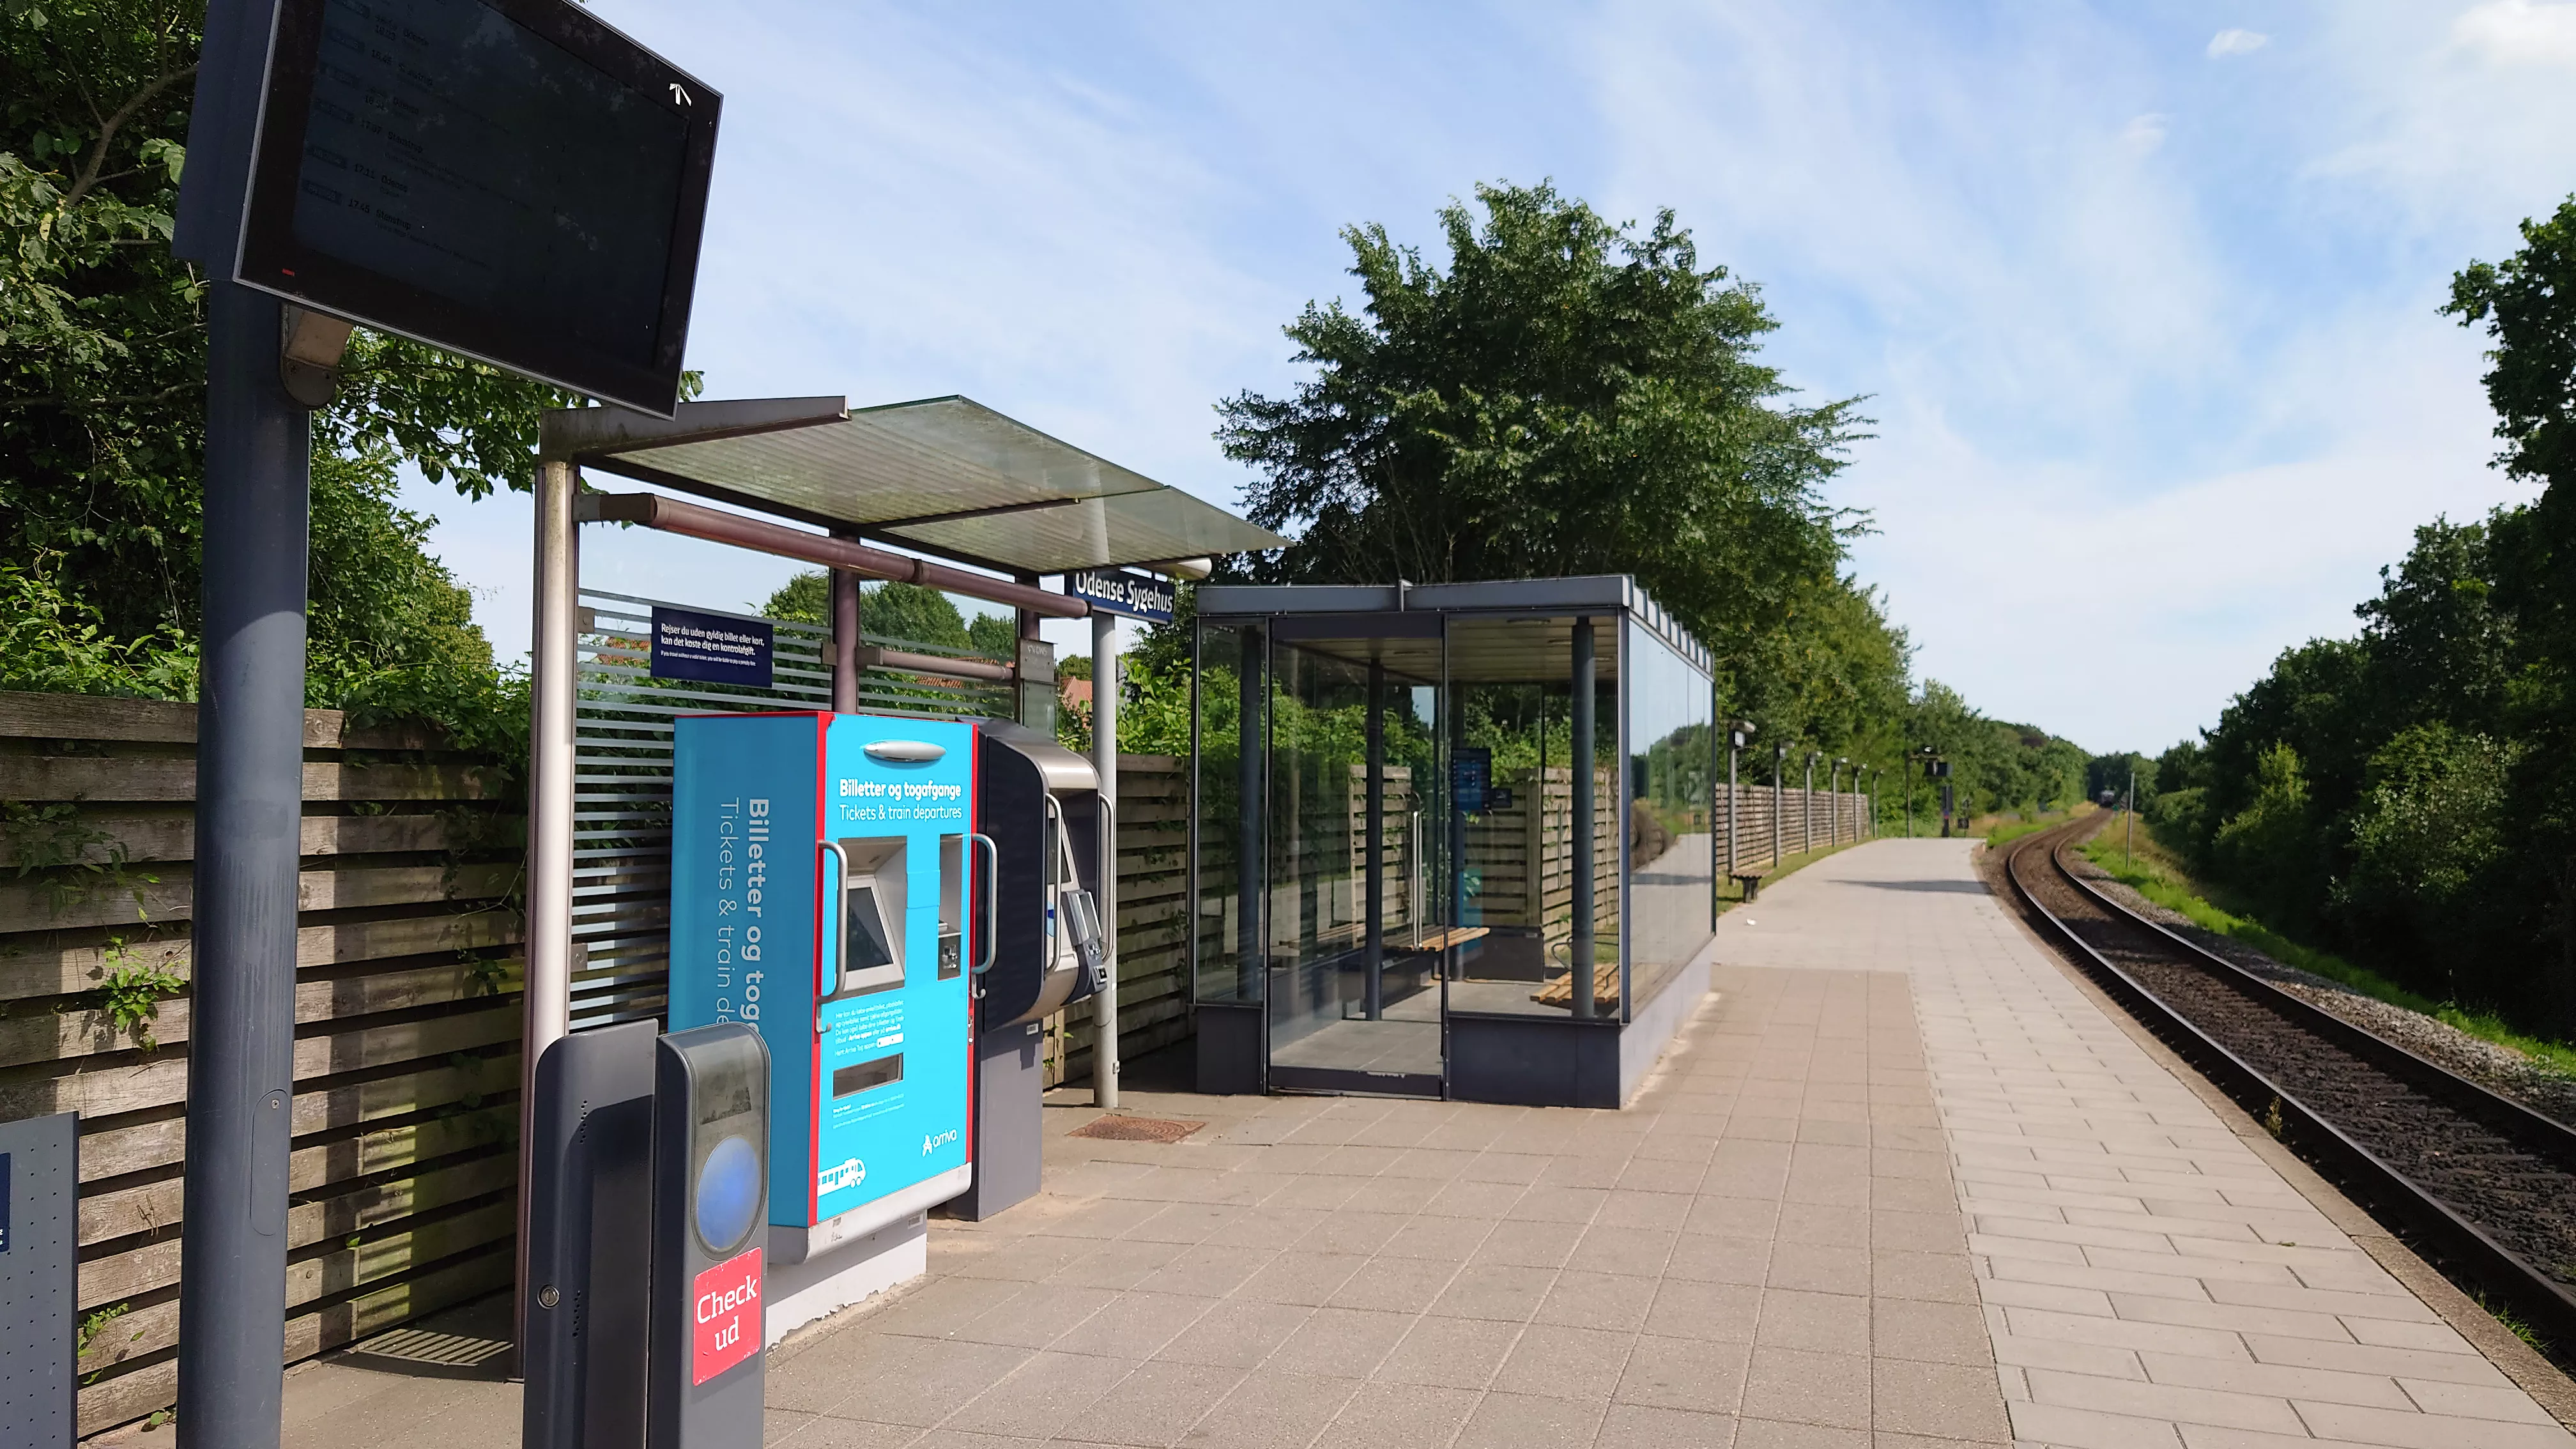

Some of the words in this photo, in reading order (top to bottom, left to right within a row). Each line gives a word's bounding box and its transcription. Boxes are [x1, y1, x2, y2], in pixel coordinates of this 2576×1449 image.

[1075, 571, 1124, 602] Odense
[1126, 579, 1173, 613] Sygehus
[661, 623, 680, 635] Rejser
[681, 625, 689, 636] du
[690, 629, 705, 638] uden
[706, 630, 724, 641] gyldig
[724, 632, 739, 642] billet
[739, 634, 751, 643] eller
[752, 636, 765, 647] kort,
[661, 635, 673, 645] kan
[673, 636, 684, 646] det
[685, 638, 702, 648] koste
[702, 641, 712, 651] dig
[721, 643, 756, 656] kontrolafgift.
[839, 778, 887, 797] Billetter
[888, 784, 902, 801] og
[903, 779, 962, 801] togafgange
[839, 804, 877, 821] Tickets
[878, 804, 886, 820] &
[888, 804, 911, 820] train
[913, 804, 962, 822] departures
[719, 797, 739, 890] Tickets
[747, 799, 769, 917] Billetter
[719, 899, 737, 917] &
[717, 925, 735, 988] train
[741, 926, 761, 962] og
[932, 1129, 957, 1148] arriva
[697, 1275, 757, 1324] Check
[714, 1315, 740, 1351] ud
